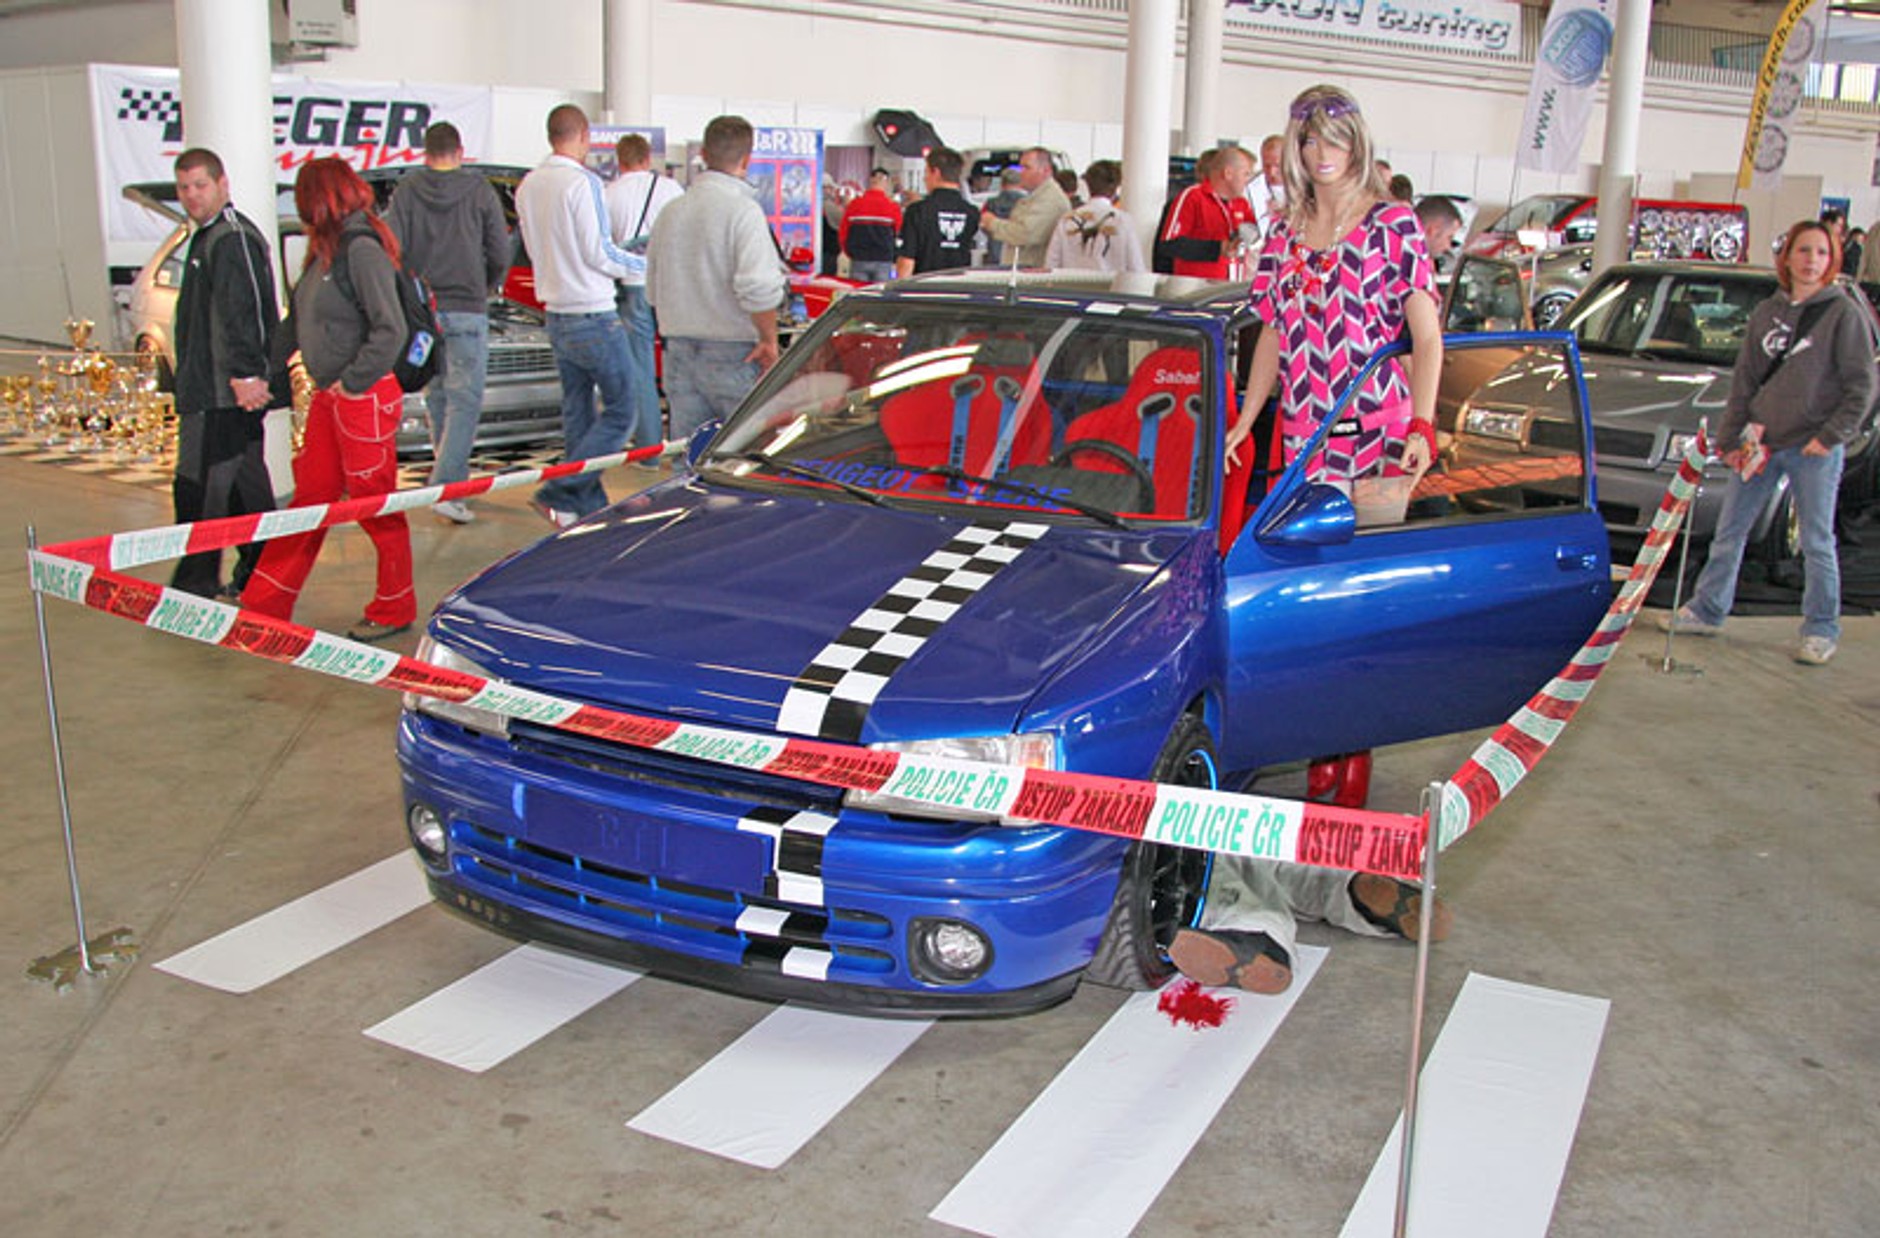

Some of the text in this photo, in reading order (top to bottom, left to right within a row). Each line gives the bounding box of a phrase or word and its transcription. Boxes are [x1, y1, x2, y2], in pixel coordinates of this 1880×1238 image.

[1377, 4, 1512, 50] tuning
[1153, 368, 1201, 385] Sabel
[890, 765, 977, 808] POLICIE
[972, 769, 1010, 811] ČR
[1014, 779, 1076, 821] VSTUP
[1155, 798, 1249, 852] POLICIE
[1252, 803, 1287, 858] ČR
[1299, 816, 1362, 865] VSTUP
[1366, 821, 1420, 875] ZAKÁ
